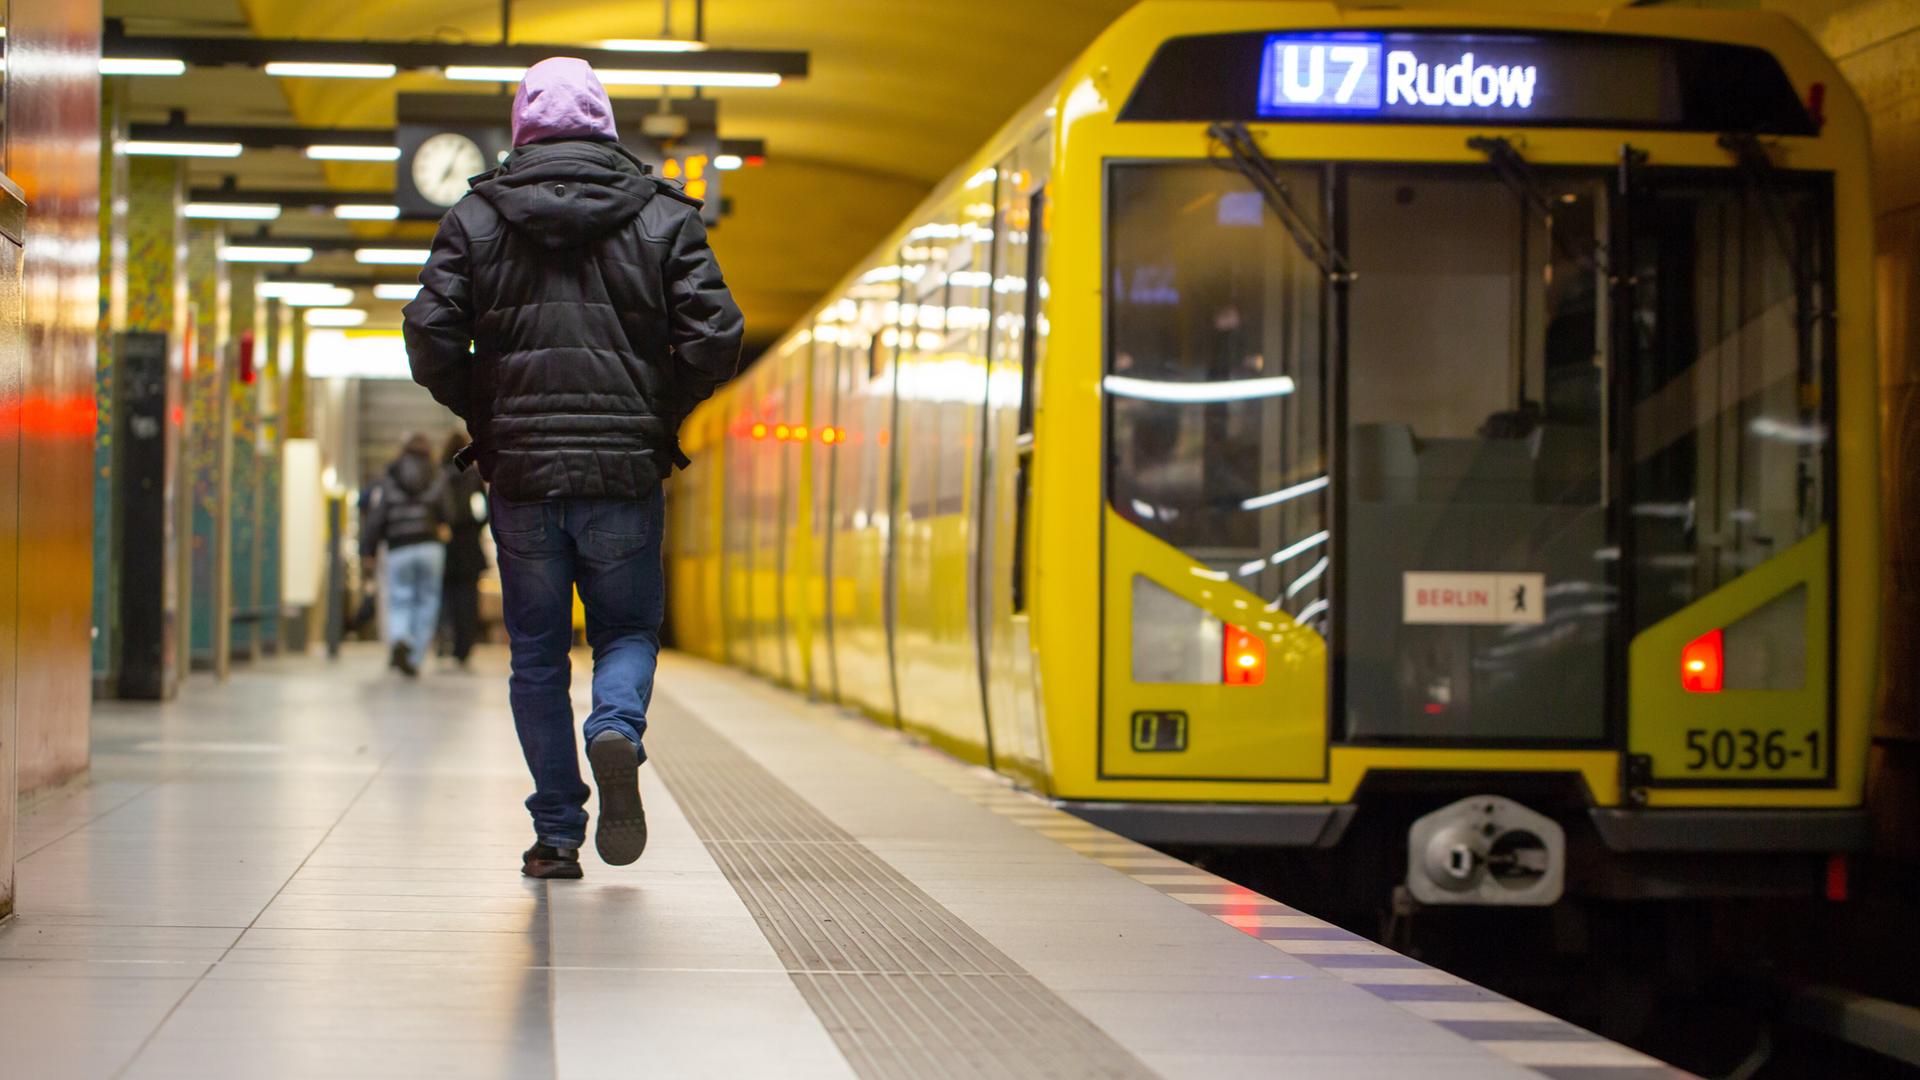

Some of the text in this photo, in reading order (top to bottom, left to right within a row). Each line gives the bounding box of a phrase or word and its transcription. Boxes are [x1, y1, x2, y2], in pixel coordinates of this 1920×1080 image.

[1281, 44, 1537, 108] U7 Rudow
[1416, 588, 1489, 607] BERLIN
[1134, 713, 1185, 750] 07
[1685, 729, 1820, 770] 5036-1
